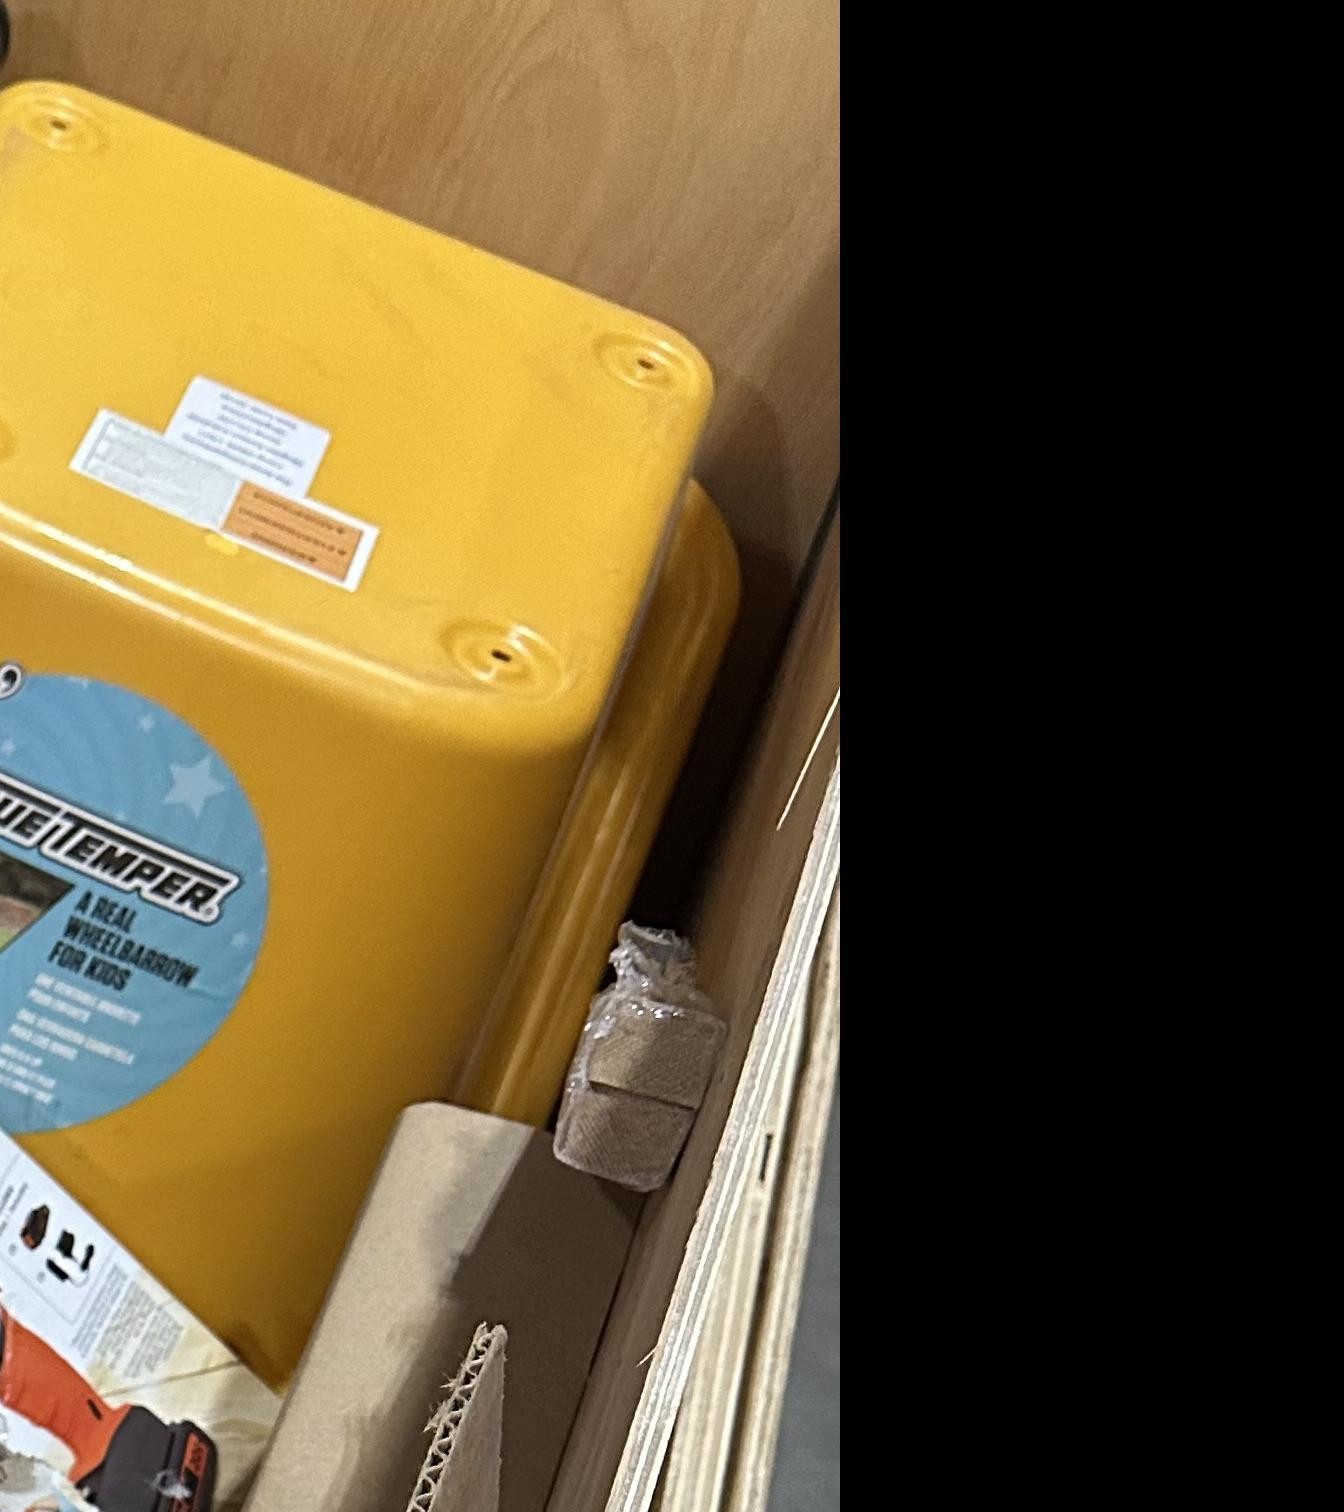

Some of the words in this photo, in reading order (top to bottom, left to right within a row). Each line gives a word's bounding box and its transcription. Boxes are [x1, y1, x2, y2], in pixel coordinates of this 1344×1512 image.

[48, 808, 234, 916] TEMPER
[75, 890, 91, 915] A
[91, 896, 137, 935] REAL
[47, 939, 87, 975] FOR
[83, 954, 133, 992] KIDS
[63, 914, 200, 989] WHEELBARROW
